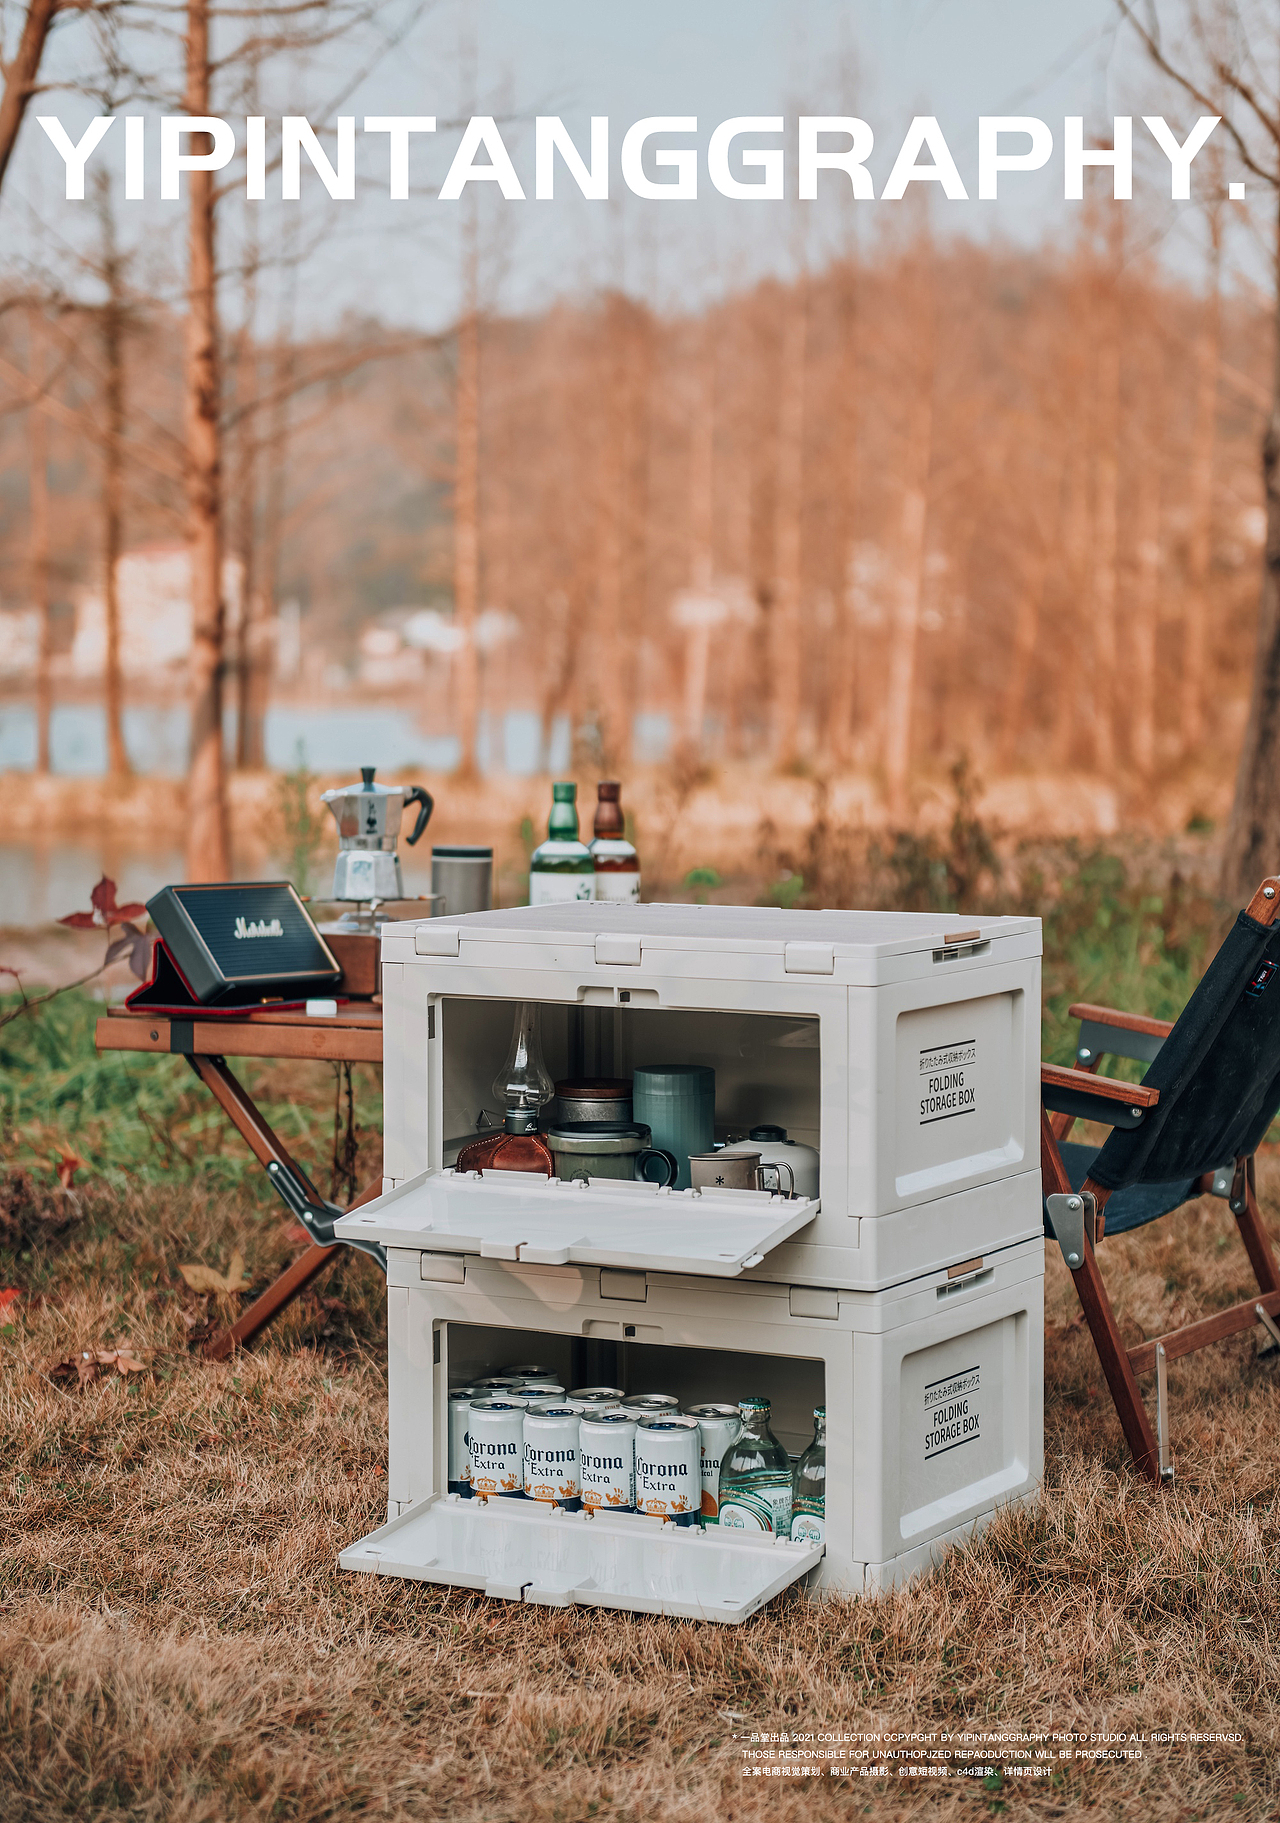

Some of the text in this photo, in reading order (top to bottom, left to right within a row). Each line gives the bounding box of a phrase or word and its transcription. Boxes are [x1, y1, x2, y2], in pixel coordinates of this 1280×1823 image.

[929, 1071, 965, 1094] FOLDING
[920, 1088, 976, 1115] STORAGE BOX
[933, 1399, 969, 1428] FOLDING
[925, 1413, 980, 1450] STORAGE BOX
[468, 1436, 518, 1456] Corona
[524, 1442, 576, 1463] Corona
[473, 1455, 506, 1470] Extra
[530, 1462, 564, 1477] Extra
[580, 1449, 624, 1470] orona
[636, 1456, 689, 1477] Corona
[700, 1459, 720, 1469] ona
[582, 1467, 611, 1484] Extra
[642, 1476, 676, 1491] Extra
